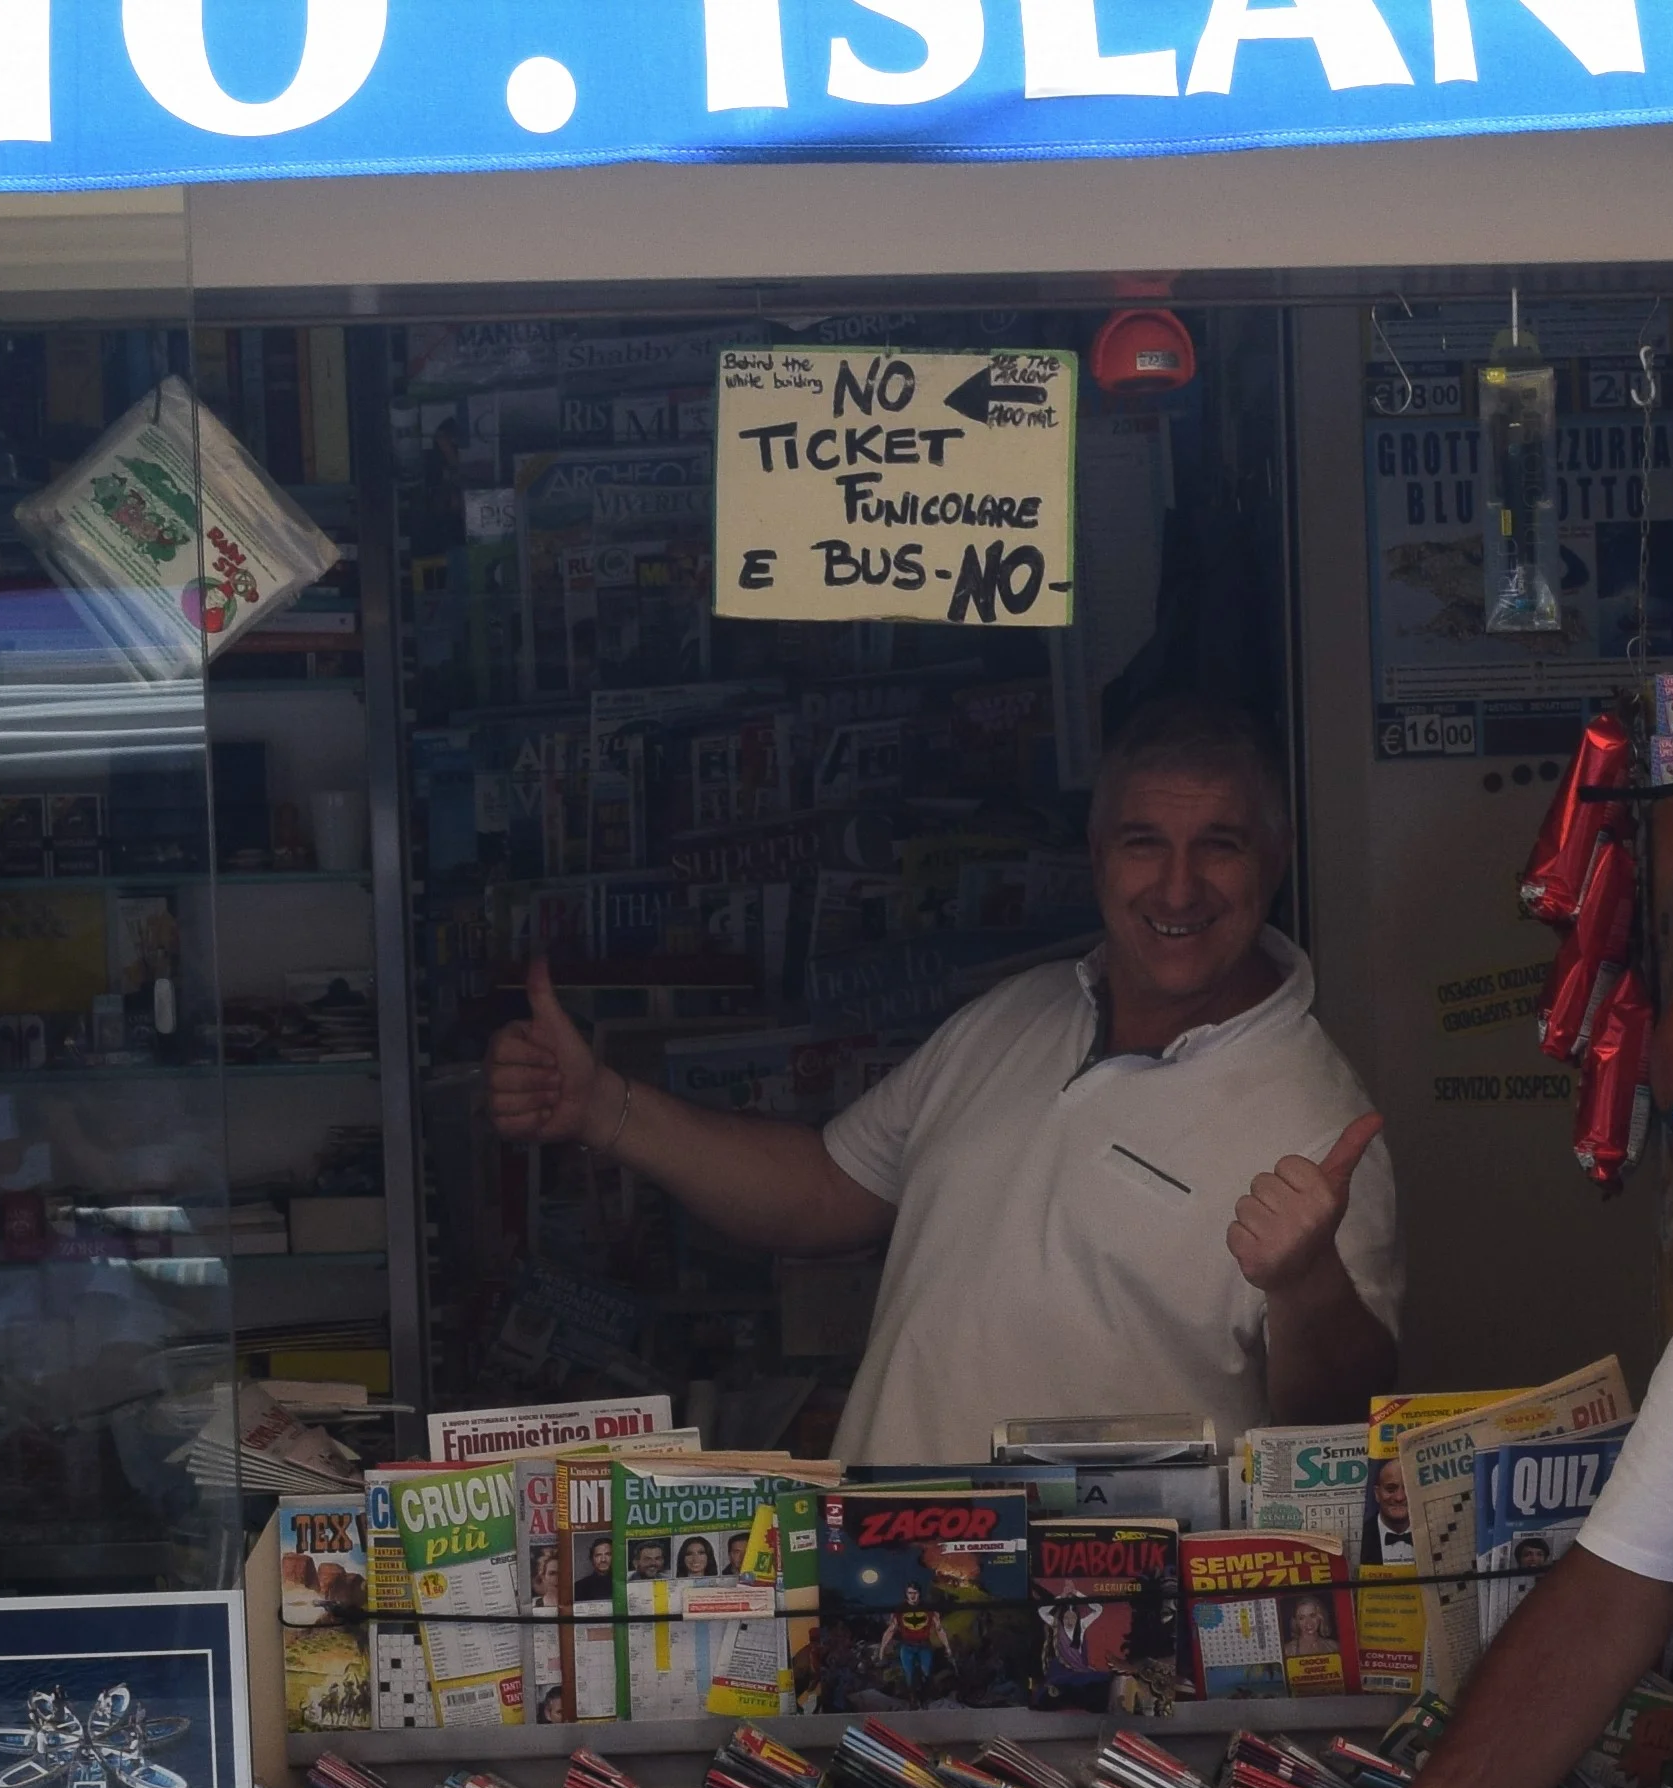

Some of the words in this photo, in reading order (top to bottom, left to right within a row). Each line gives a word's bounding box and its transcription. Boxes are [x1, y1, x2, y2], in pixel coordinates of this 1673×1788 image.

[773, 372, 823, 394] building
[782, 356, 814, 373] the
[832, 356, 916, 418] NO
[739, 421, 966, 473] TICKET
[738, 548, 778, 590] E
[1406, 718, 1441, 748] 16
[1445, 723, 1473, 745] 00
[1433, 1075, 1500, 1101] SERVIZIO
[1505, 1075, 1572, 1100] SOSPESO
[1415, 1433, 1476, 1465] CIVILTÀ
[1512, 1453, 1600, 1517] QUIZ
[291, 1513, 353, 1554] TEX
[425, 1522, 490, 1565] più
[857, 1506, 997, 1547] ZAGOR
[1040, 1538, 1168, 1578] DIABOLIK
[1092, 1582, 1143, 1593] SACRIFICIO
[1365, 1652, 1383, 1661] CON
[1386, 1652, 1414, 1661] TUTTE
